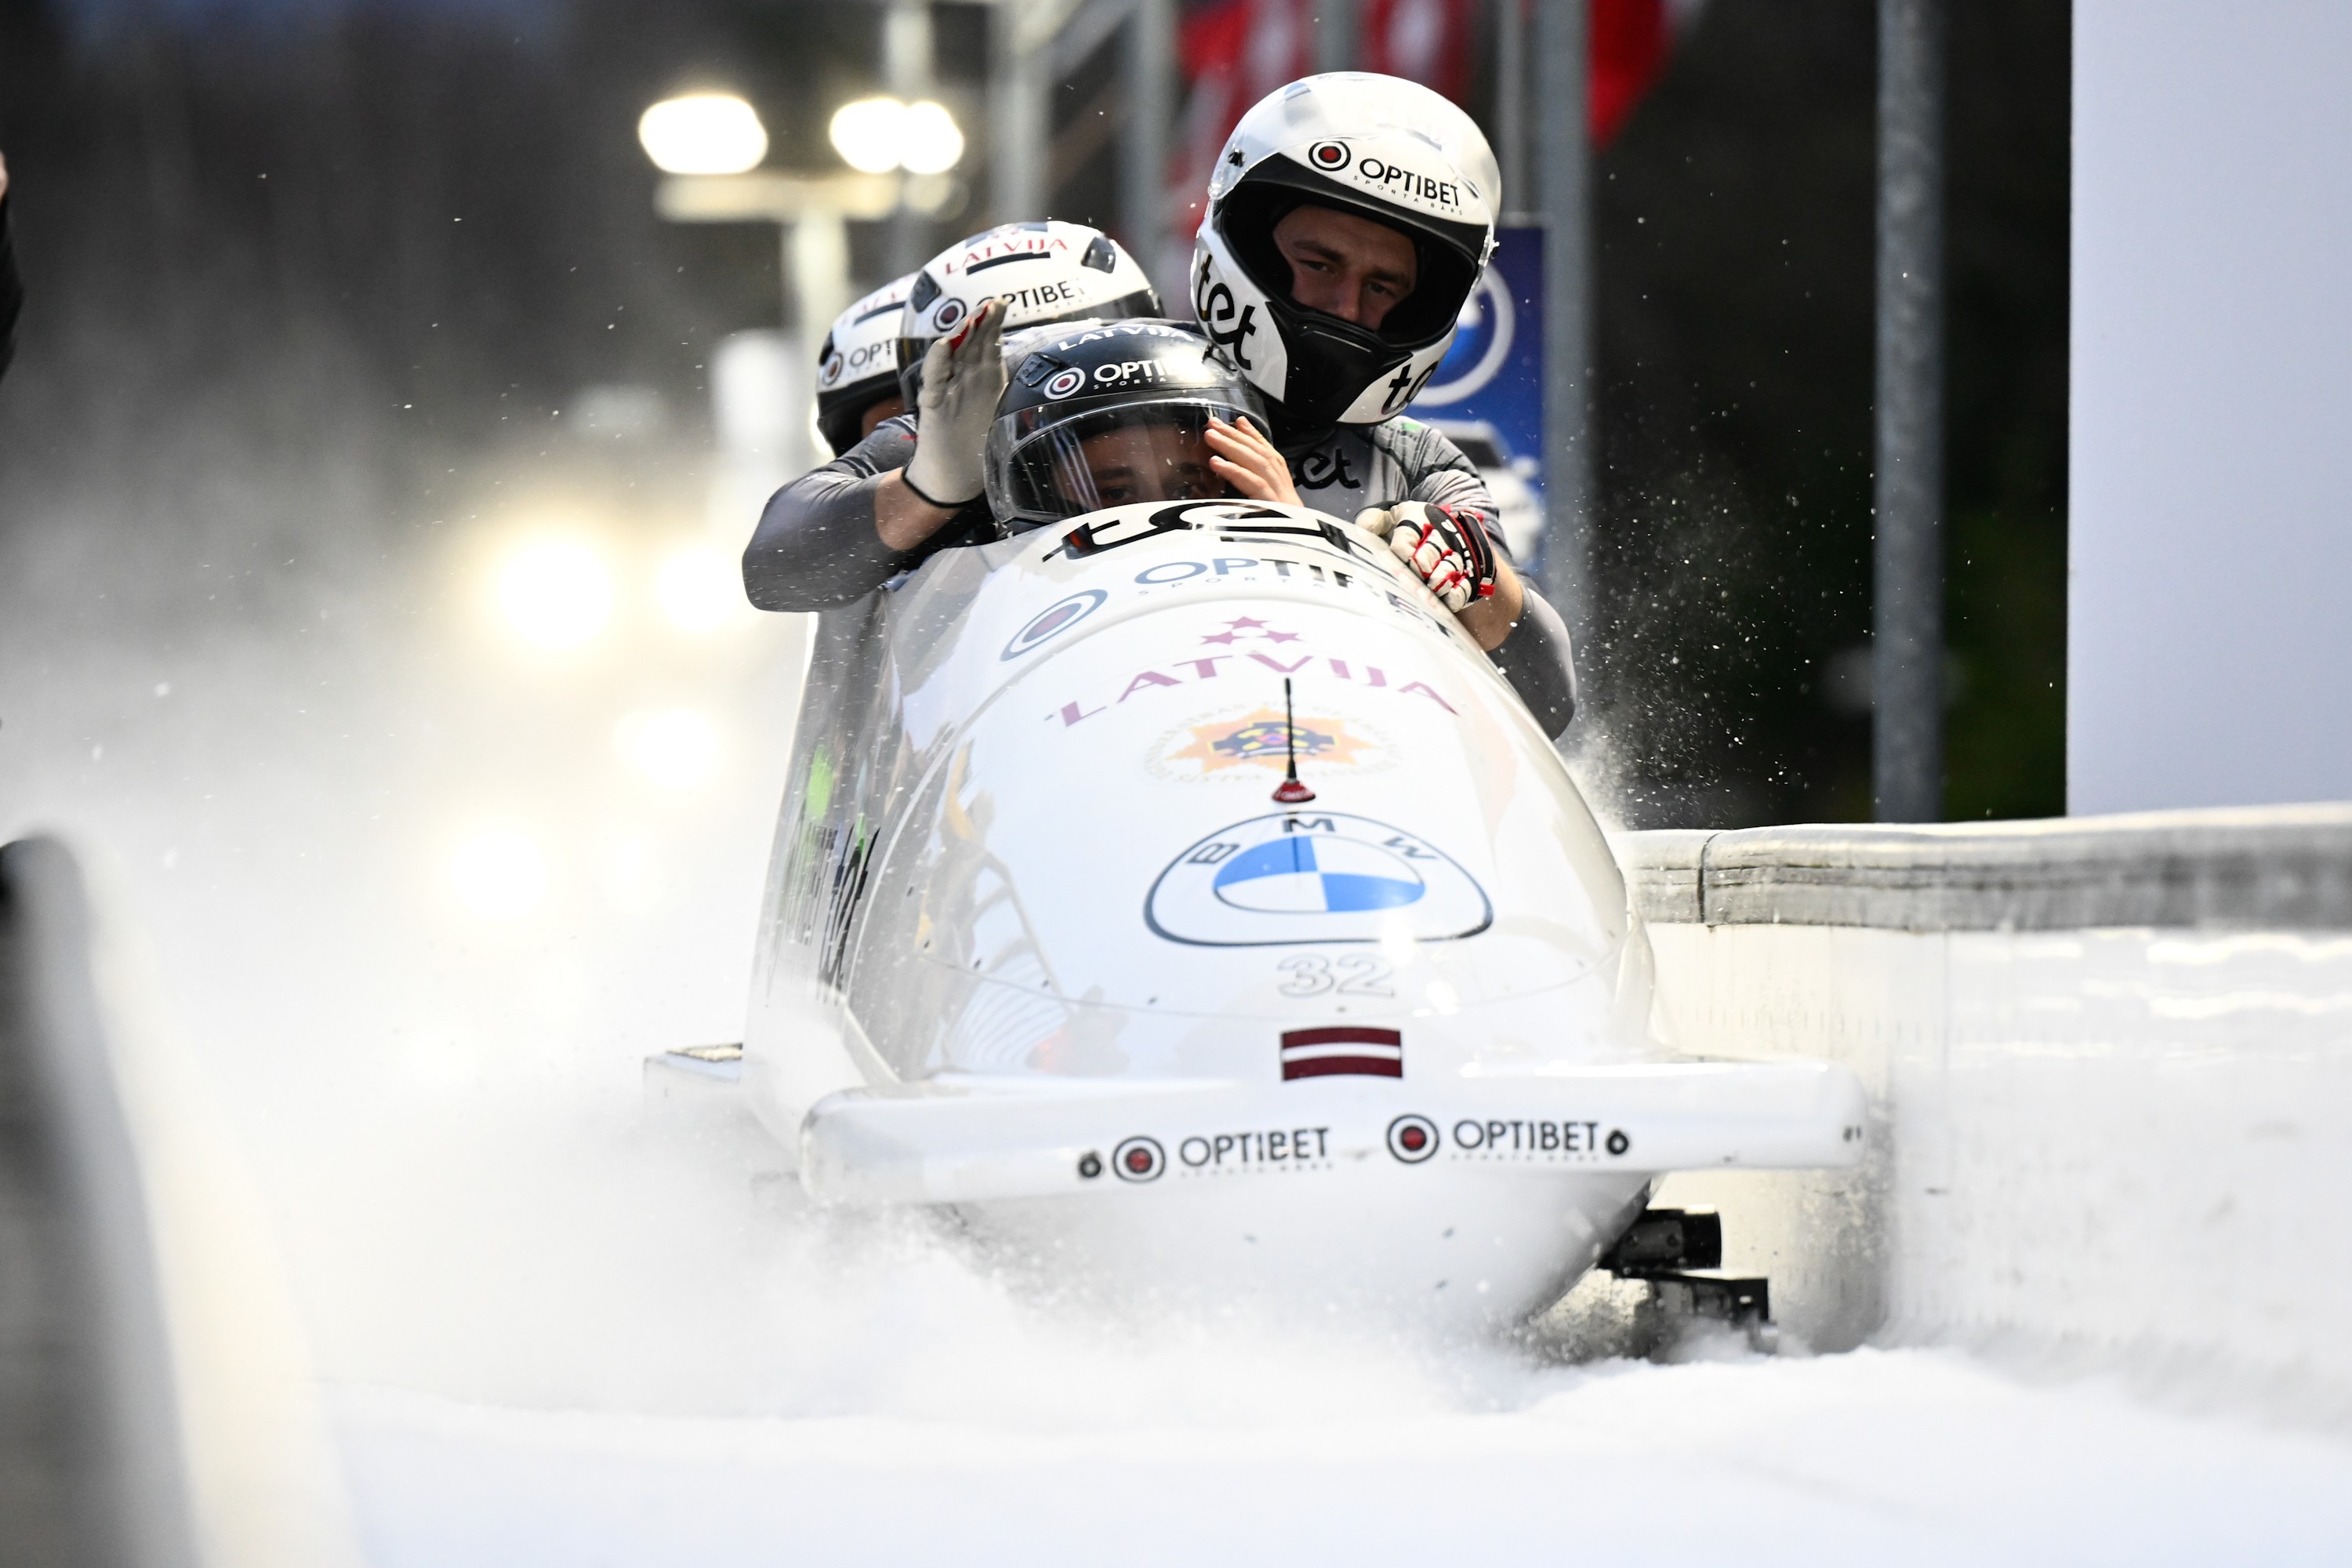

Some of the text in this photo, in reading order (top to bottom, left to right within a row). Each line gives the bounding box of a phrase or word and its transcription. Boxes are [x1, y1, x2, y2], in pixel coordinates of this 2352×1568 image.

[1353, 175, 1419, 203] SPORTA
[1359, 158, 1459, 207] OPTIBET
[945, 238, 1068, 275] LATVIJA
[1196, 253, 1257, 371] tet
[1058, 326, 1195, 352] LATVIJA
[1058, 653, 1460, 728] LATVIJA
[1185, 817, 1438, 865] BMW
[1277, 953, 1396, 998] 32
[1179, 1126, 1330, 1167] OPTIBET
[1453, 1119, 1599, 1151] OPTIBET
